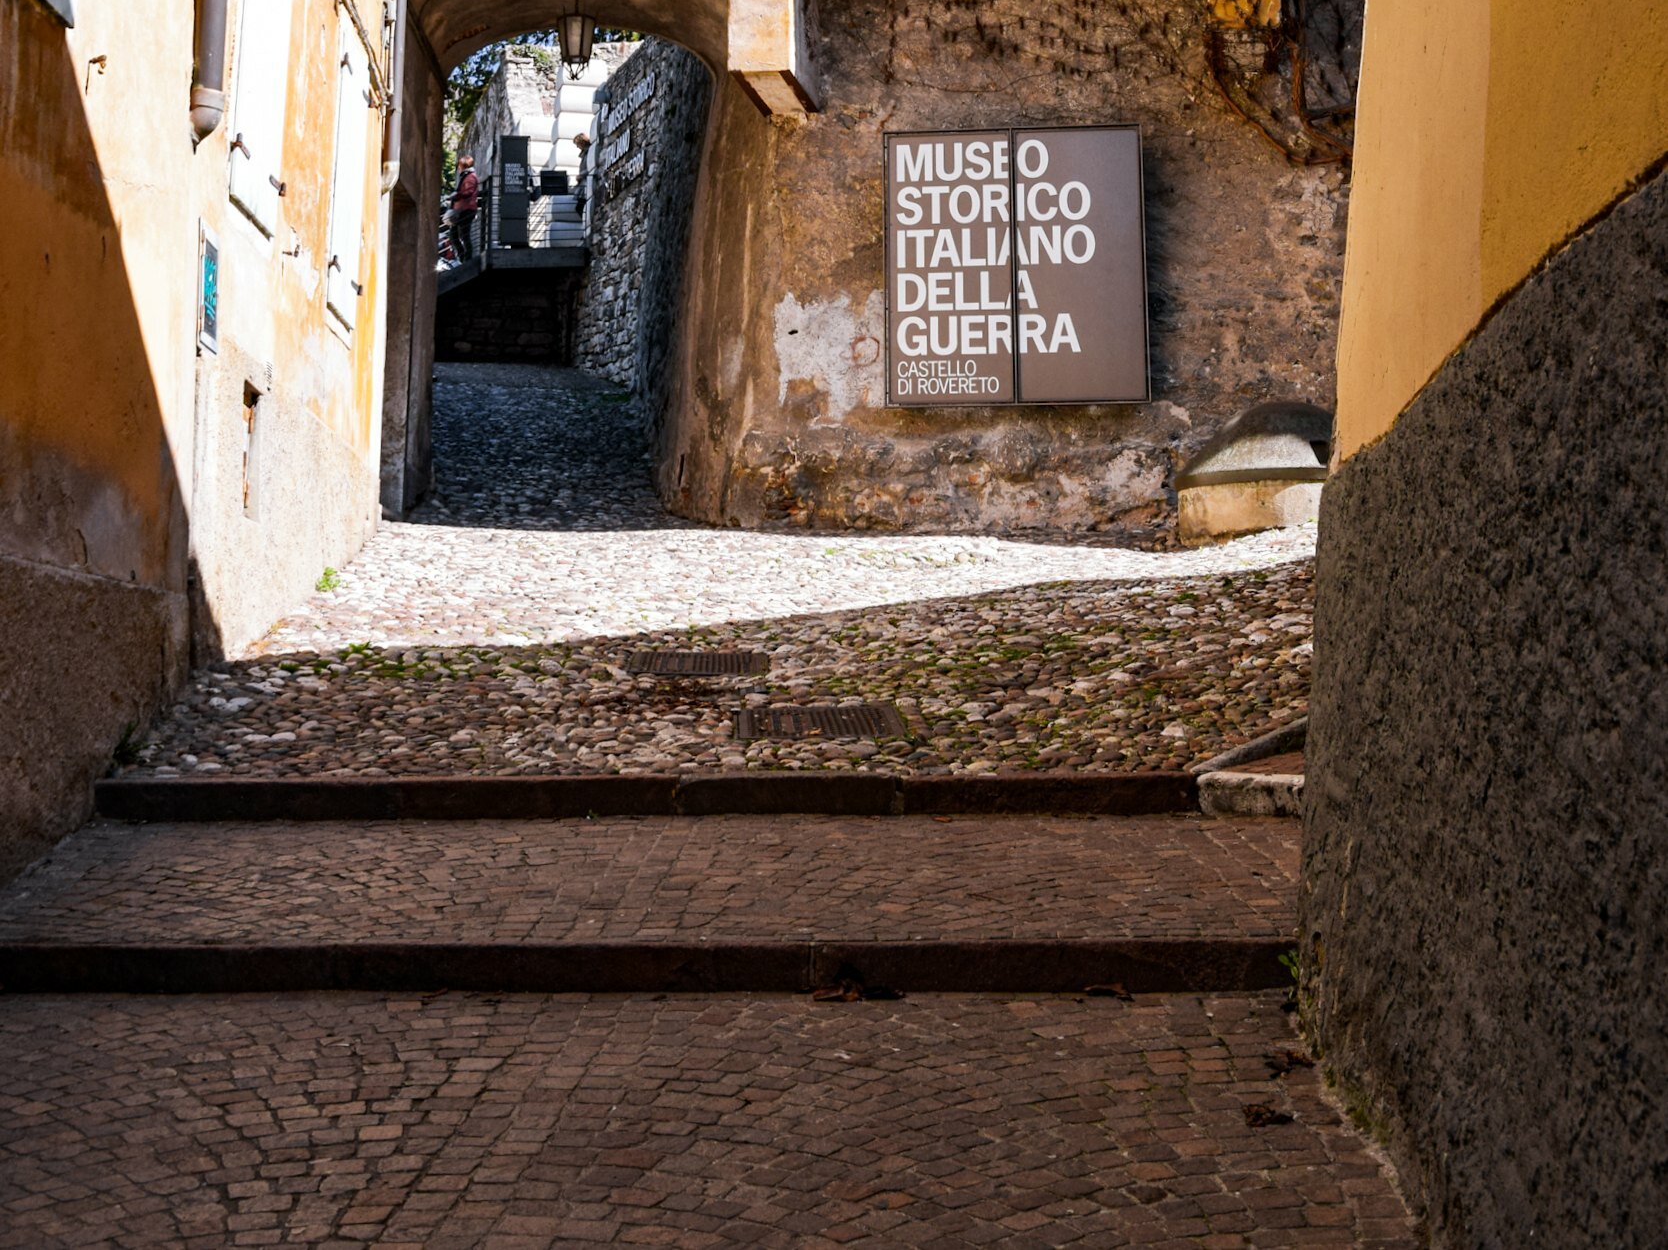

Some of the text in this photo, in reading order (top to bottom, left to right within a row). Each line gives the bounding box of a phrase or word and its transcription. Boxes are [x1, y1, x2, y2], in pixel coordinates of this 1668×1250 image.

[896, 139, 1049, 183] MUSEO
[896, 181, 1091, 225] STORICO
[896, 224, 1096, 268] ITALIANO
[897, 270, 1038, 312] DELLA
[896, 313, 1081, 356] GUERRA
[897, 359, 976, 378] CASTELLO
[898, 376, 1000, 395] DI ROVERETO
